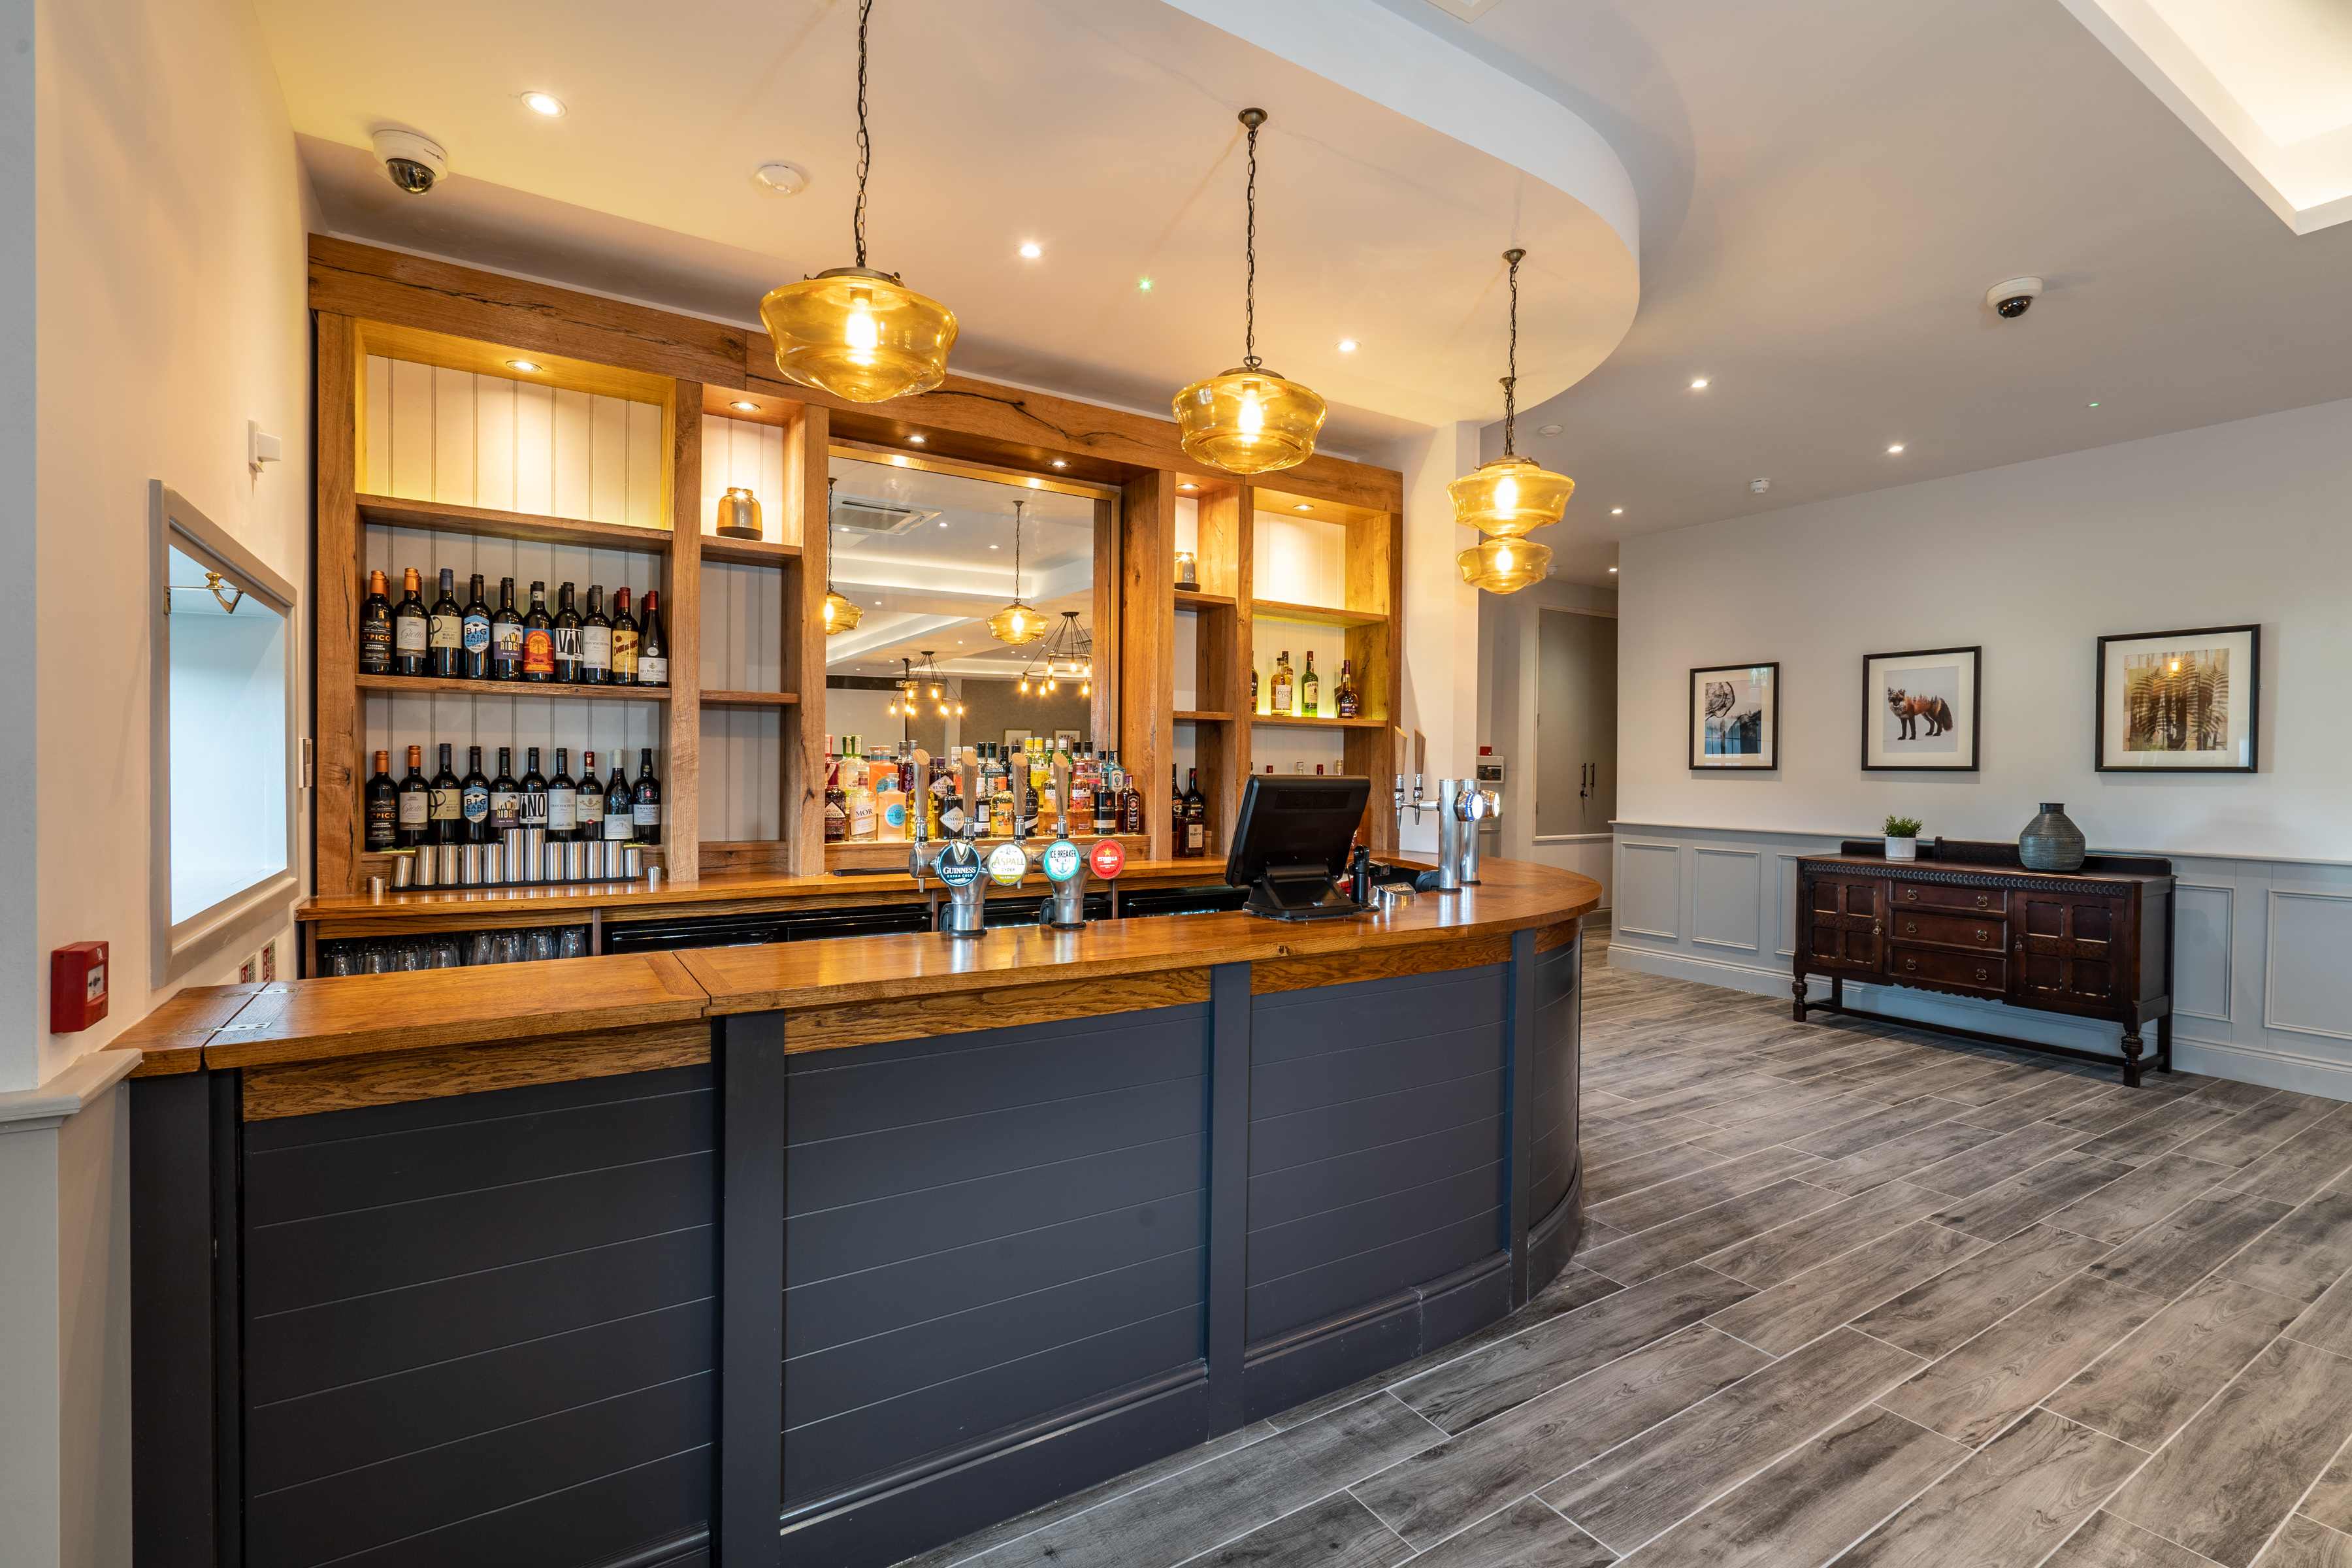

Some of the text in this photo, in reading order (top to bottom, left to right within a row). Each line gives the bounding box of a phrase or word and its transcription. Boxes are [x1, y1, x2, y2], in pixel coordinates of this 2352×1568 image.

[400, 628, 424, 640] Giotto
[500, 642, 521, 651] RIDGE
[402, 802, 423, 814] Giotto
[497, 809, 516, 818] RIDGE
[1049, 849, 1077, 858] ICE BREAKER
[991, 857, 1025, 868] ASPALL
[943, 866, 977, 875] GUINNESS
